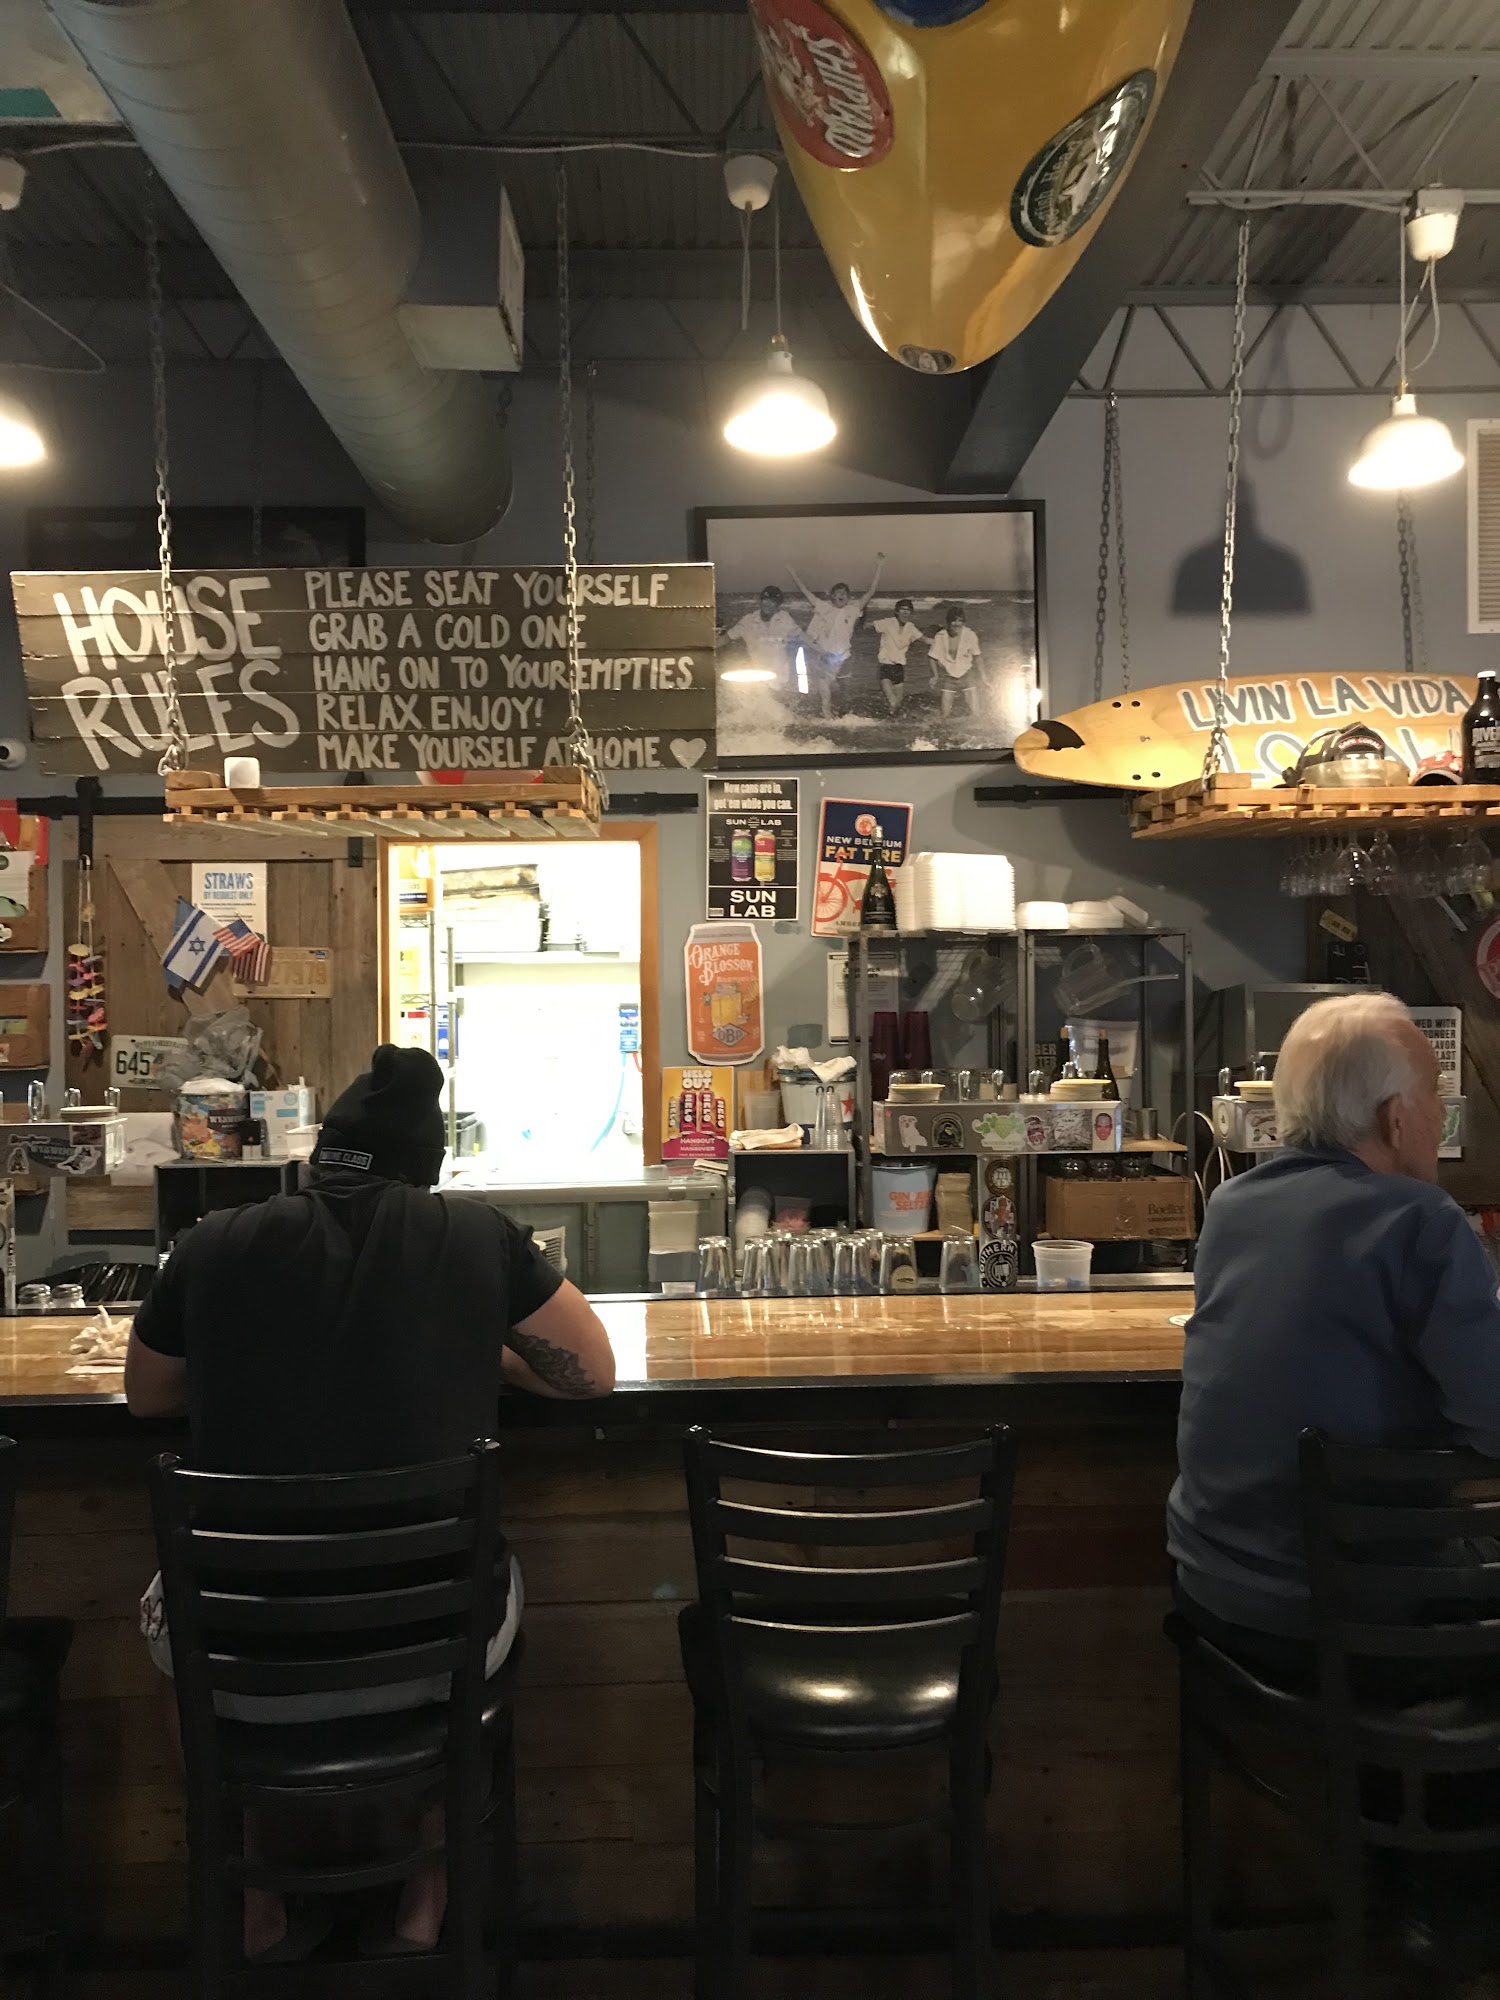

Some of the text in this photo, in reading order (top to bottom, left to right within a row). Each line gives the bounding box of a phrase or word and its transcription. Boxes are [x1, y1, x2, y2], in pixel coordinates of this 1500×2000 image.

[305, 569, 670, 609] PLEASE SEAT YOURSELF
[54, 576, 282, 674] HOUSE
[309, 613, 587, 652] GRAB A COLD ONE
[313, 653, 694, 692] HANG ON TO YOUR EMPTIES
[1300, 676, 1370, 716] LA
[1366, 677, 1473, 717] VIDA
[61, 659, 299, 771] RULES
[316, 693, 544, 731] RELAX ENJOY!
[317, 734, 400, 770] MAKE
[408, 733, 537, 769] YOURSELF
[590, 735, 661, 769] HOME
[1358, 737, 1382, 750] CORAL
[724, 782, 740, 794] New
[741, 784, 759, 794] cans
[760, 784, 772, 794] are
[714, 798, 726, 810] get
[742, 797, 762, 809] while
[763, 799, 776, 811] you
[826, 835, 902, 848] NEW BELIUM
[825, 845, 902, 863] FAT TRE
[204, 872, 254, 890] STRAWS
[204, 890, 212, 899] BY
[212, 890, 237, 899] REQUEST
[729, 889, 777, 903] SUN
[729, 904, 776, 918] LAB
[689, 943, 741, 969] ORANGE
[698, 959, 754, 986] BLOSSOM
[1435, 1018, 1456, 1028] WITH
[116, 1050, 151, 1076] 645
[682, 1078, 712, 1089] OUT
